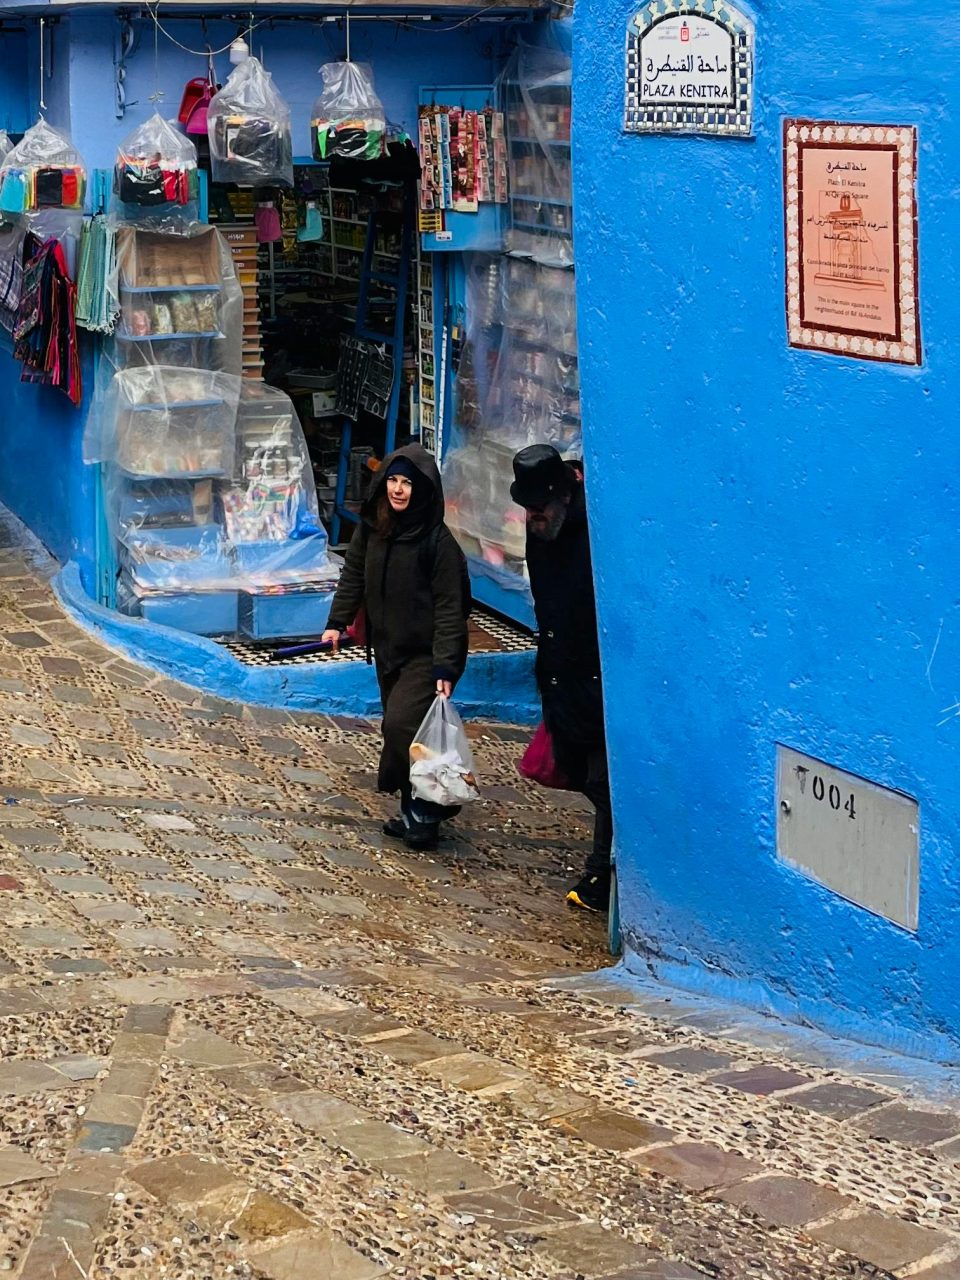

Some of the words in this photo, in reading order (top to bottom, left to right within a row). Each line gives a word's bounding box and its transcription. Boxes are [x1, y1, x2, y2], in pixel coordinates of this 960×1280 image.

[645, 54, 694, 83] القنيطرة
[698, 55, 728, 74] ساحة
[643, 83, 676, 97] PLAZA
[680, 83, 729, 98] KENITRA
